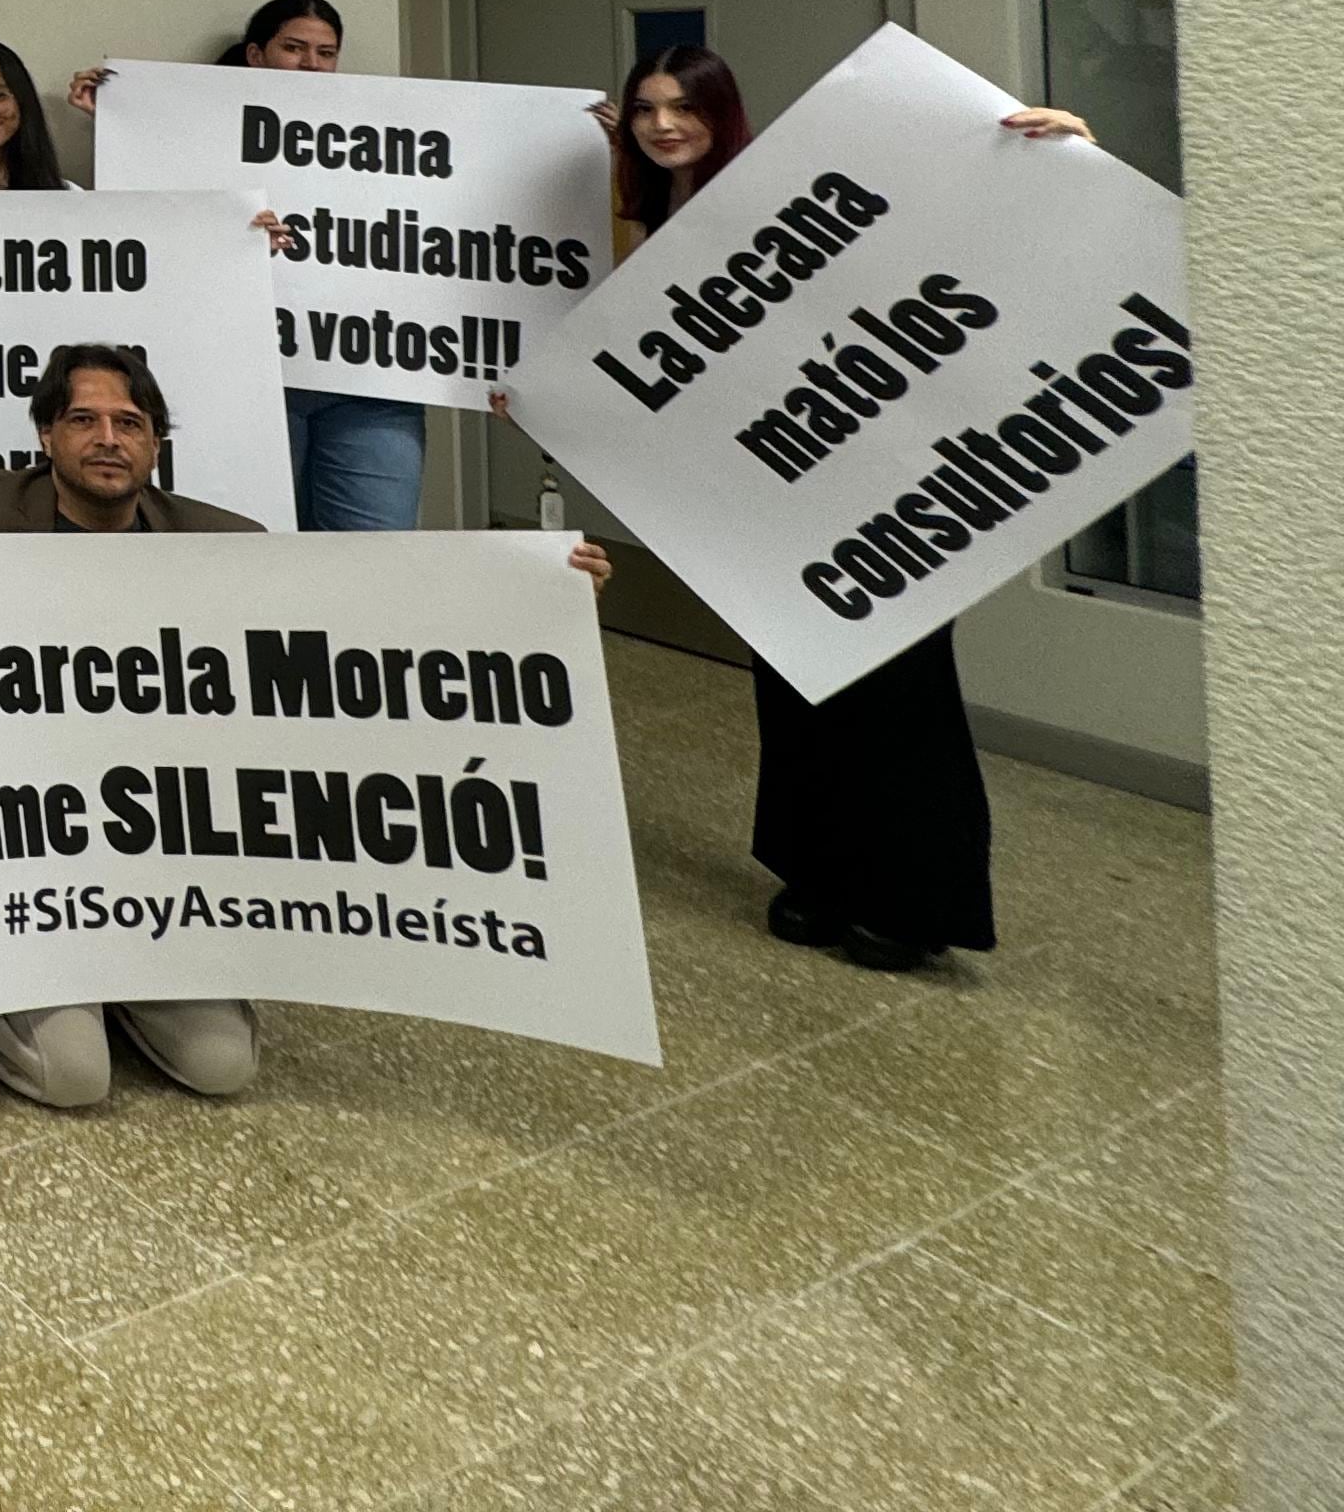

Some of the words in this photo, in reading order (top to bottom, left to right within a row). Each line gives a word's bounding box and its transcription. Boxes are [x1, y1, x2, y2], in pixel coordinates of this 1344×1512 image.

[241, 105, 453, 179] Decana
[81, 238, 147, 293] no
[271, 208, 591, 290] studiantes
[592, 330, 707, 414] La
[664, 172, 889, 355] decana
[734, 333, 910, 485] mató
[848, 273, 999, 375] los
[245, 629, 574, 728] Moreno
[102, 757, 548, 881] SILENCIÓ!
[4, 886, 548, 961] #SíSoyAsambleísta
